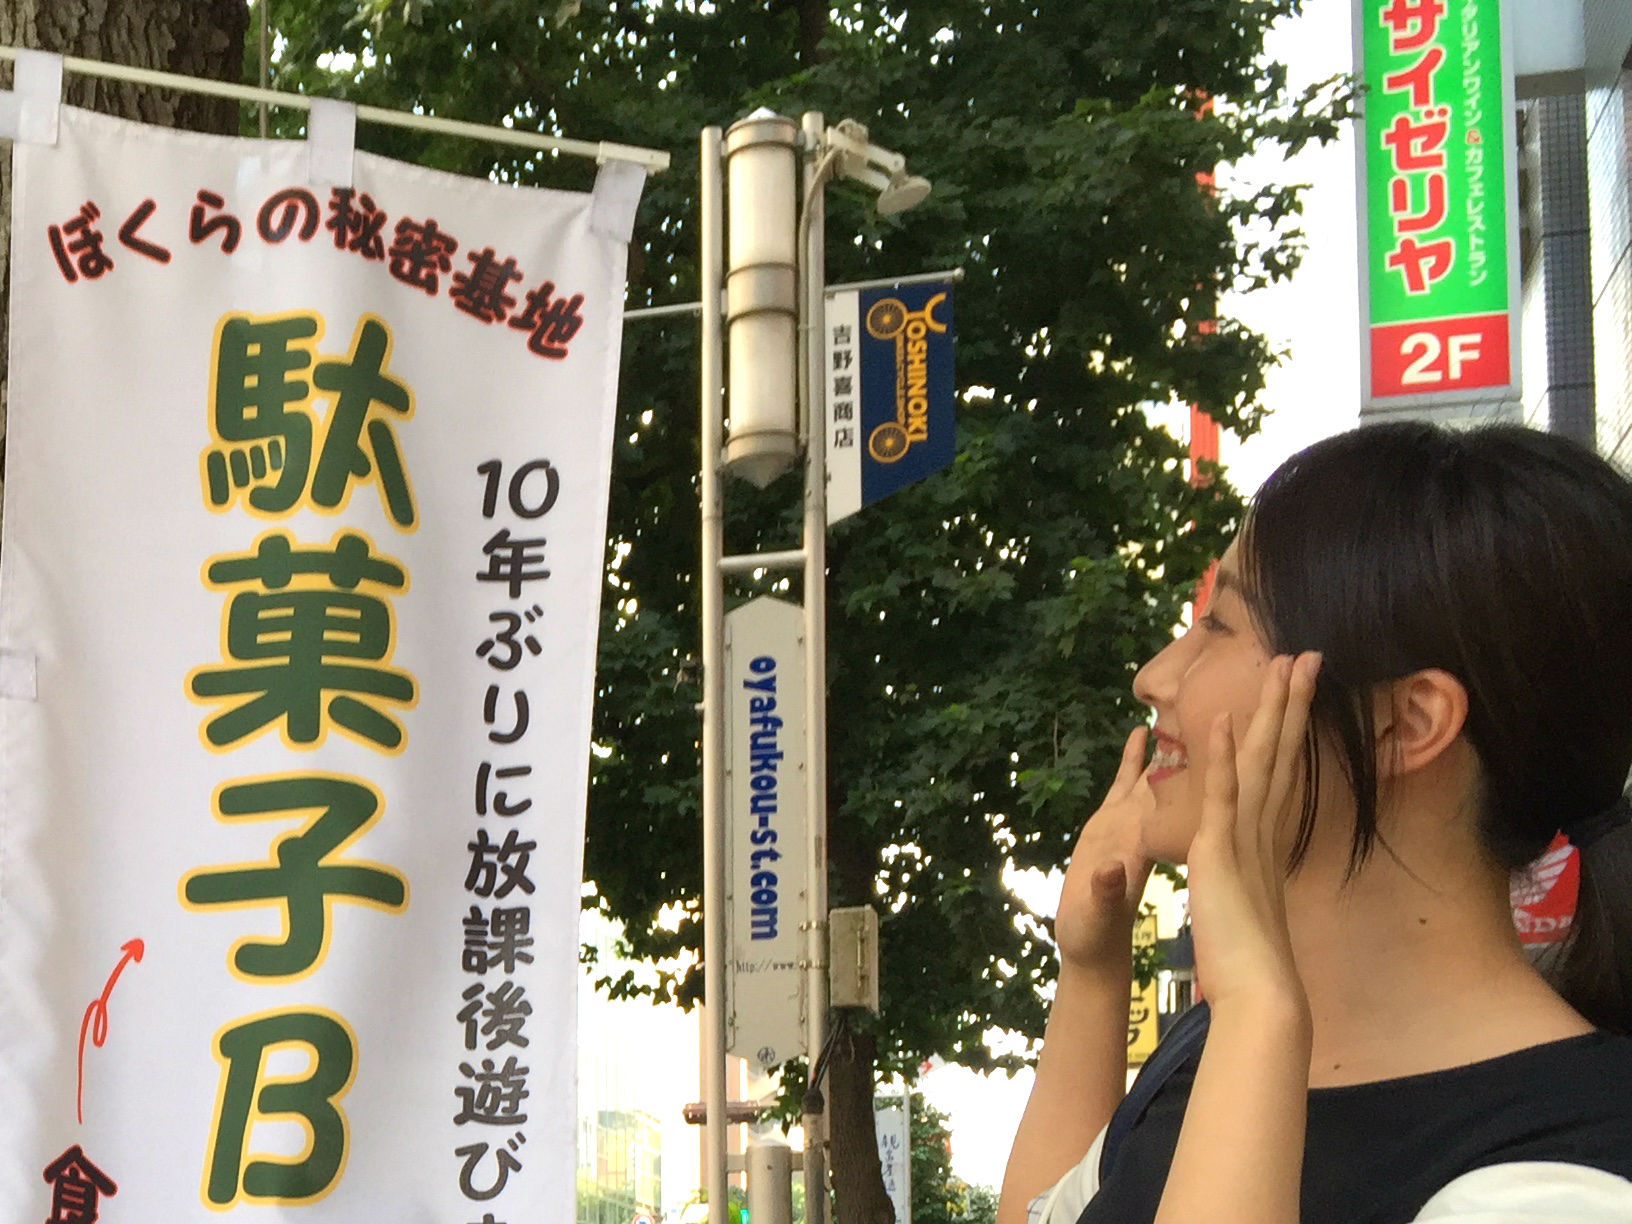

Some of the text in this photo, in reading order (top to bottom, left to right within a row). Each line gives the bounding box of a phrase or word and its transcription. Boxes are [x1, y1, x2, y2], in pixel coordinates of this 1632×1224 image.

[1379, 0, 1455, 296] サイゼリヤ
[47, 186, 584, 360] ぼくらの秘密基地
[1399, 332, 1483, 386] 2F
[743, 655, 784, 941] oyafukou-st.com
